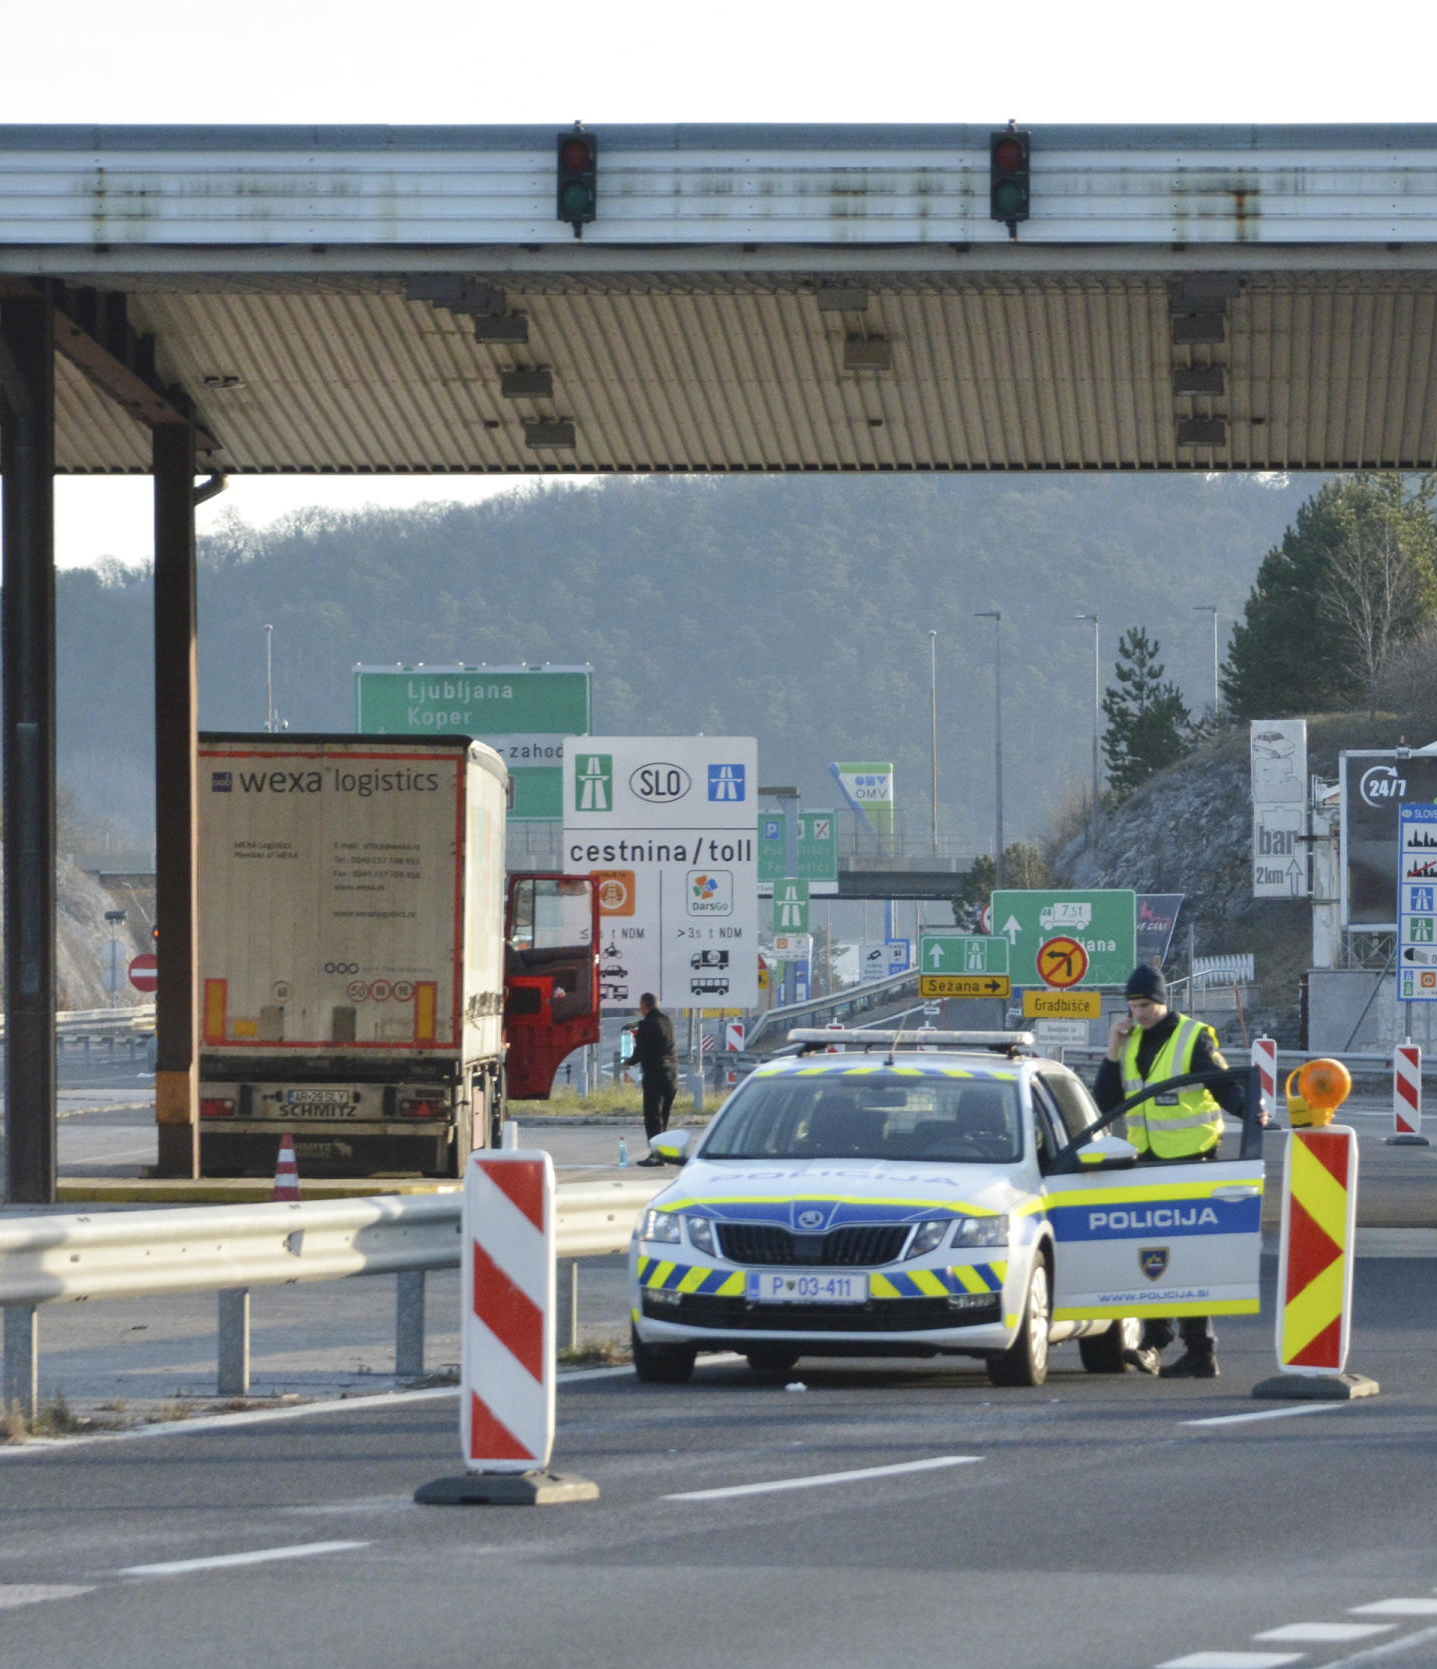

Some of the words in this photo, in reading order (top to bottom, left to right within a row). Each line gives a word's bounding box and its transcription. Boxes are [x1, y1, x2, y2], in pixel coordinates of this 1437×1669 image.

[407, 681, 514, 703] Ljubljana
[408, 707, 472, 729] Koper
[239, 771, 323, 793] wexa
[335, 768, 439, 797] logistics
[640, 769, 681, 796] SLO
[1369, 780, 1407, 797] 24/7
[856, 789, 888, 798] OMV
[1258, 825, 1299, 855] bar
[1256, 866, 1284, 884] 2km
[692, 902, 729, 911] DarsGo
[621, 928, 645, 938] NDM
[719, 928, 742, 938] NDM
[929, 979, 980, 992] Sežana
[1034, 997, 1091, 1012] Gradbišče
[279, 1104, 357, 1117] SCHMITZ
[1089, 1207, 1219, 1230] POLICIJA
[798, 1277, 851, 1297] 03-411
[1098, 1289, 1210, 1303] WWW.POLICIJA.SI
